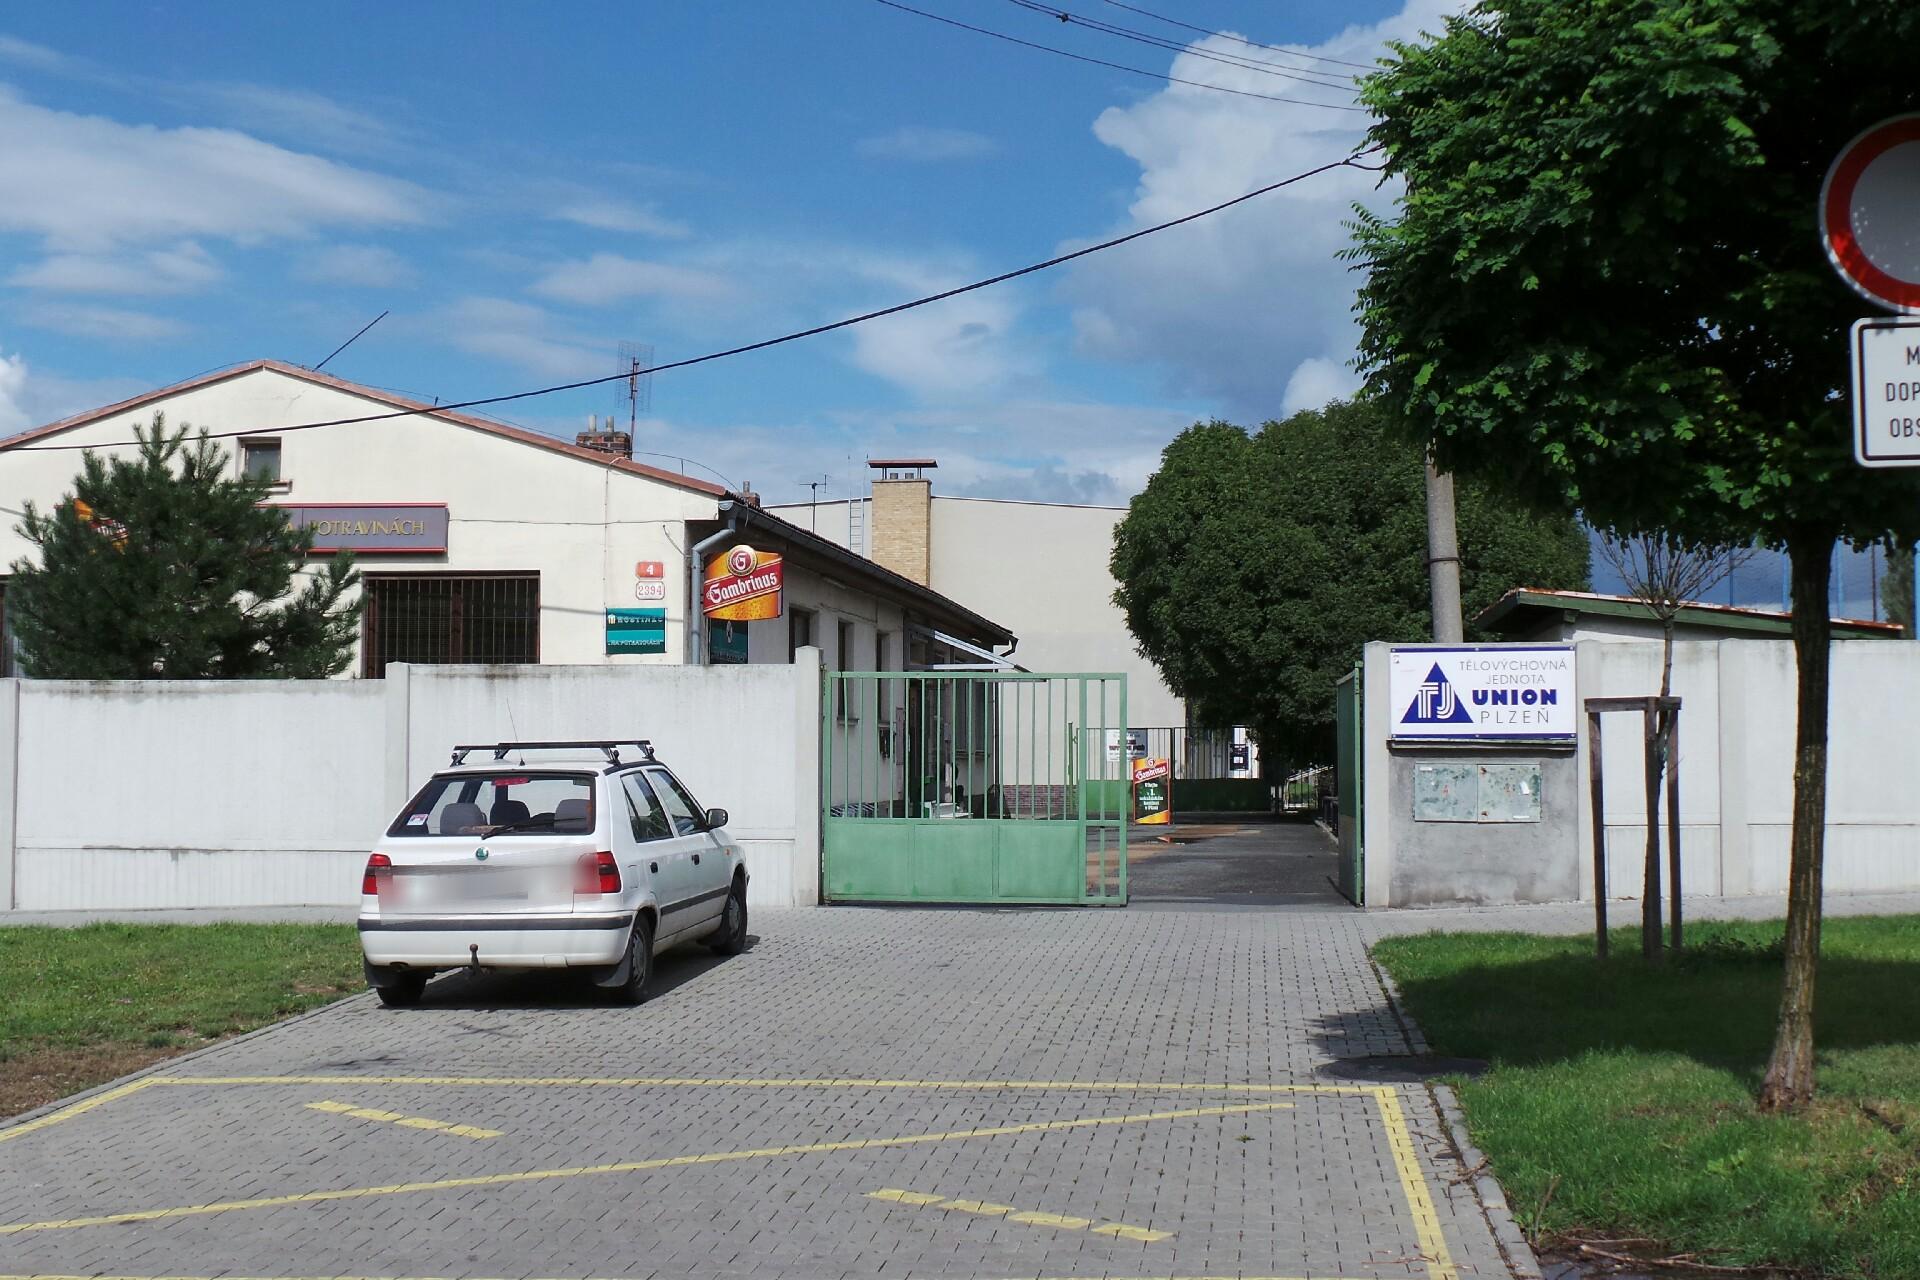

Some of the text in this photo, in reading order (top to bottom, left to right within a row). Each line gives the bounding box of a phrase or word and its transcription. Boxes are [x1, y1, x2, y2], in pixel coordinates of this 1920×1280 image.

[1886, 382, 1920, 401] DOP
[646, 564, 654, 575] 4
[638, 585, 662, 596] 2394
[707, 572, 778, 604] Gambrinus
[1460, 658, 1567, 671] TĚLOVÝCHOVNÁ
[1485, 674, 1546, 685] JEDNOTA
[1417, 682, 1456, 719] TJ
[1472, 689, 1557, 706] UNION
[1481, 708, 1549, 724] PLZEŇ
